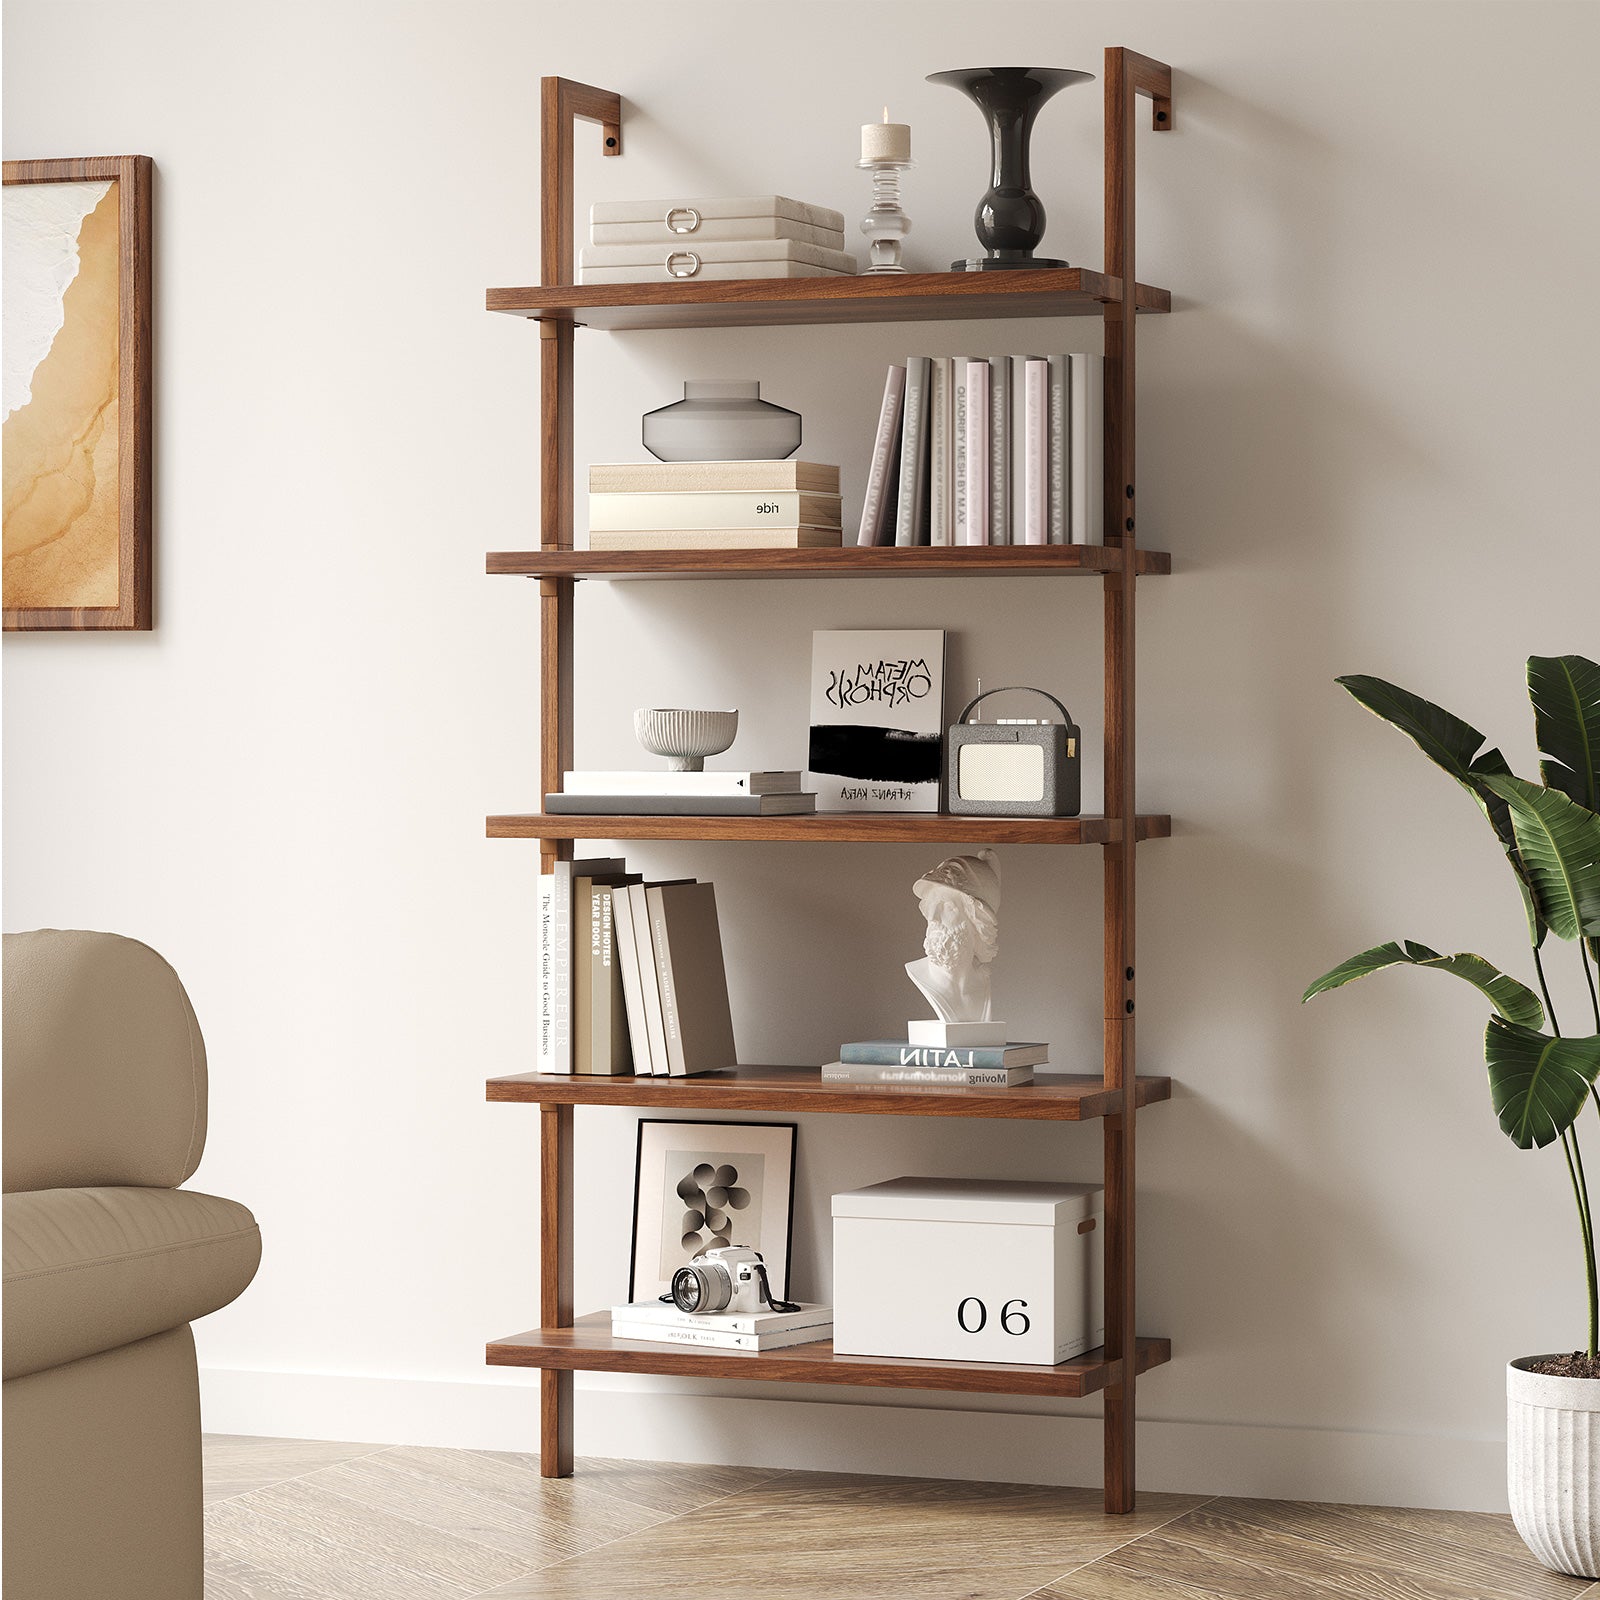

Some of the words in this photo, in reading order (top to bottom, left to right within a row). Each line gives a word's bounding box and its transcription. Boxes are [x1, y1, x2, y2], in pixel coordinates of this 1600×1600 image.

[906, 386, 919, 435] UNWRAP
[957, 386, 966, 443] QUADRIFY
[993, 385, 1003, 434] UNWRAP
[1051, 384, 1062, 433] UNWRAP
[904, 437, 917, 463] UVW
[957, 445, 966, 477] MESH
[993, 437, 1003, 463] UVW
[1051, 435, 1062, 462] UVW
[903, 465, 914, 490] MAP
[957, 480, 966, 495] BY
[993, 465, 1003, 490] MAP
[1051, 464, 1062, 489] MAP
[868, 488, 880, 504] BY
[902, 492, 912, 507] BY
[993, 491, 1003, 508] BY
[1051, 490, 1062, 506] BY
[542, 893, 551, 911] The
[592, 894, 601, 918] YEAR
[602, 894, 611, 929] DESIGN
[542, 913, 551, 951] Monocle
[592, 920, 601, 947] BOOK
[602, 931, 611, 967] HOTELS
[542, 952, 551, 979] Guide
[556, 909, 567, 1048] LEMPEREUR
[542, 981, 551, 990] to
[542, 992, 551, 1016] Good
[542, 1019, 551, 1055] Business
[957, 1296, 1030, 1336] 06
